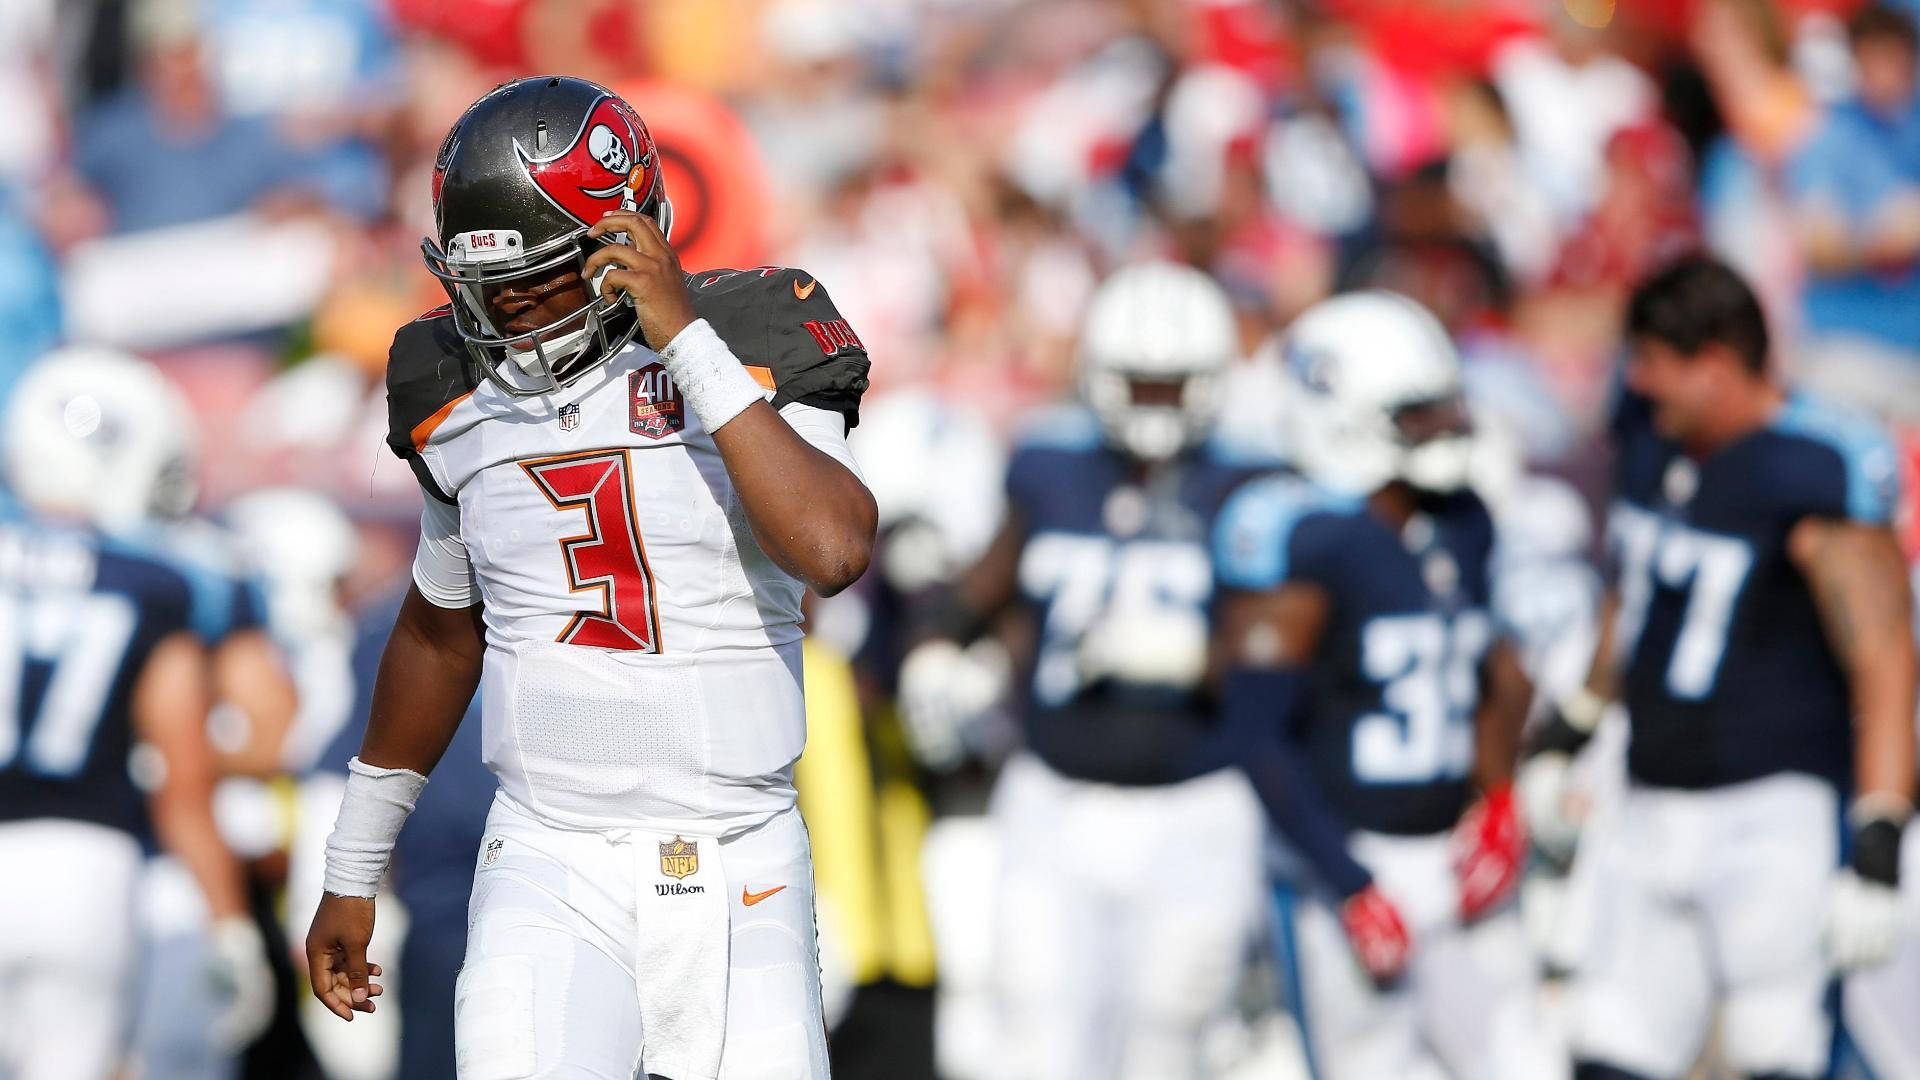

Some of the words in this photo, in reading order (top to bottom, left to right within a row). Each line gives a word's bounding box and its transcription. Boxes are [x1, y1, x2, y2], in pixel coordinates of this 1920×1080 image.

[637, 369, 674, 406] 40
[561, 415, 578, 429] NFL
[517, 447, 664, 654] 3
[486, 848, 500, 863] NFL
[664, 856, 695, 874] NFL
[655, 883, 705, 896] Wilson
